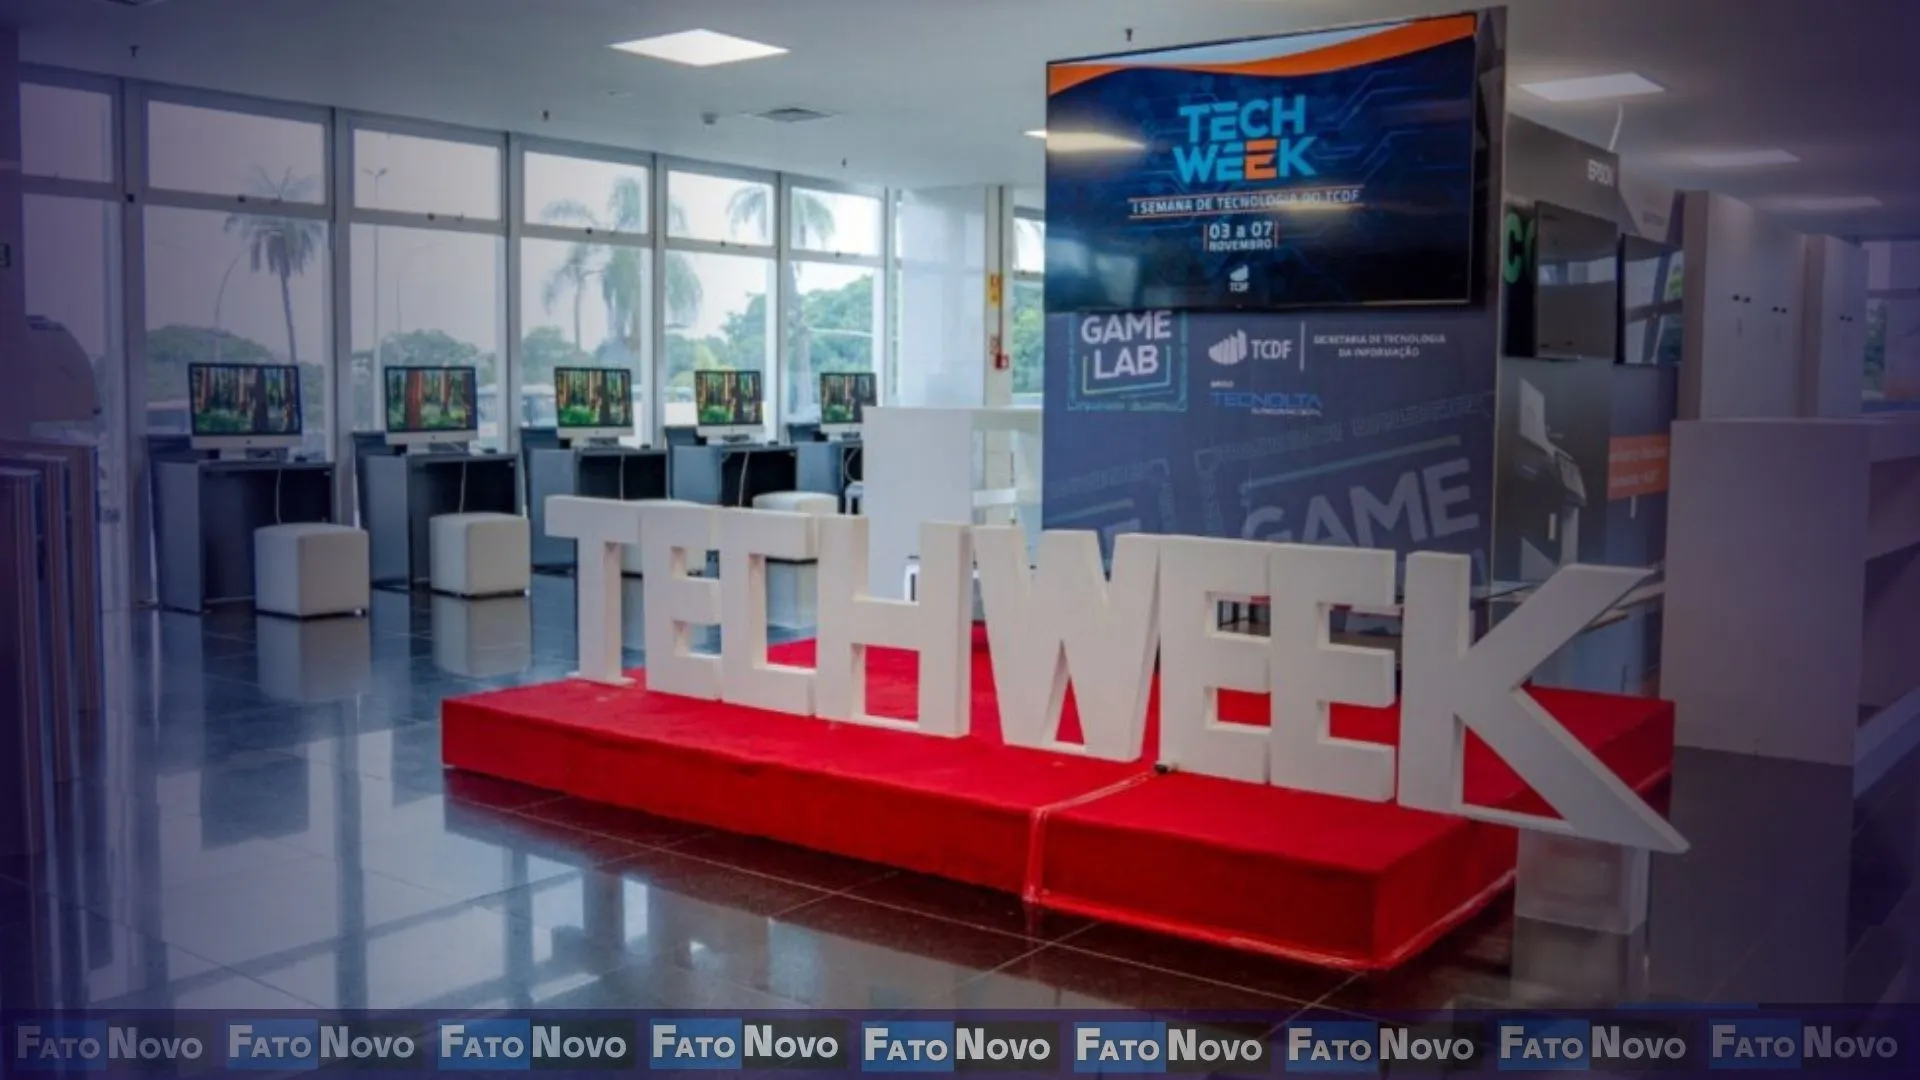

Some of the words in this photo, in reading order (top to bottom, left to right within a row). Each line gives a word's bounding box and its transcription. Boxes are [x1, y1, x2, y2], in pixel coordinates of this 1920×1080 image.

[1179, 94, 1307, 143] TECH
[1172, 136, 1318, 184] WEEK
[1140, 198, 1193, 215] SEMANA
[1196, 197, 1212, 211] DE
[1216, 191, 1298, 209] TECNOLOGIA
[1209, 223, 1231, 239] 03
[1236, 225, 1246, 238] a
[1251, 221, 1273, 237] 07
[1209, 239, 1273, 252] NOVEMBRO
[1081, 310, 1173, 344] GAME
[1313, 334, 1367, 345] SECRETARIA
[1369, 334, 1381, 344] DE
[1384, 333, 1446, 344] TECNOLOGIA
[1094, 345, 1159, 379] LAB
[1251, 339, 1293, 360] TCDF
[545, 496, 974, 740] TECH
[972, 524, 1690, 853] WEEK
